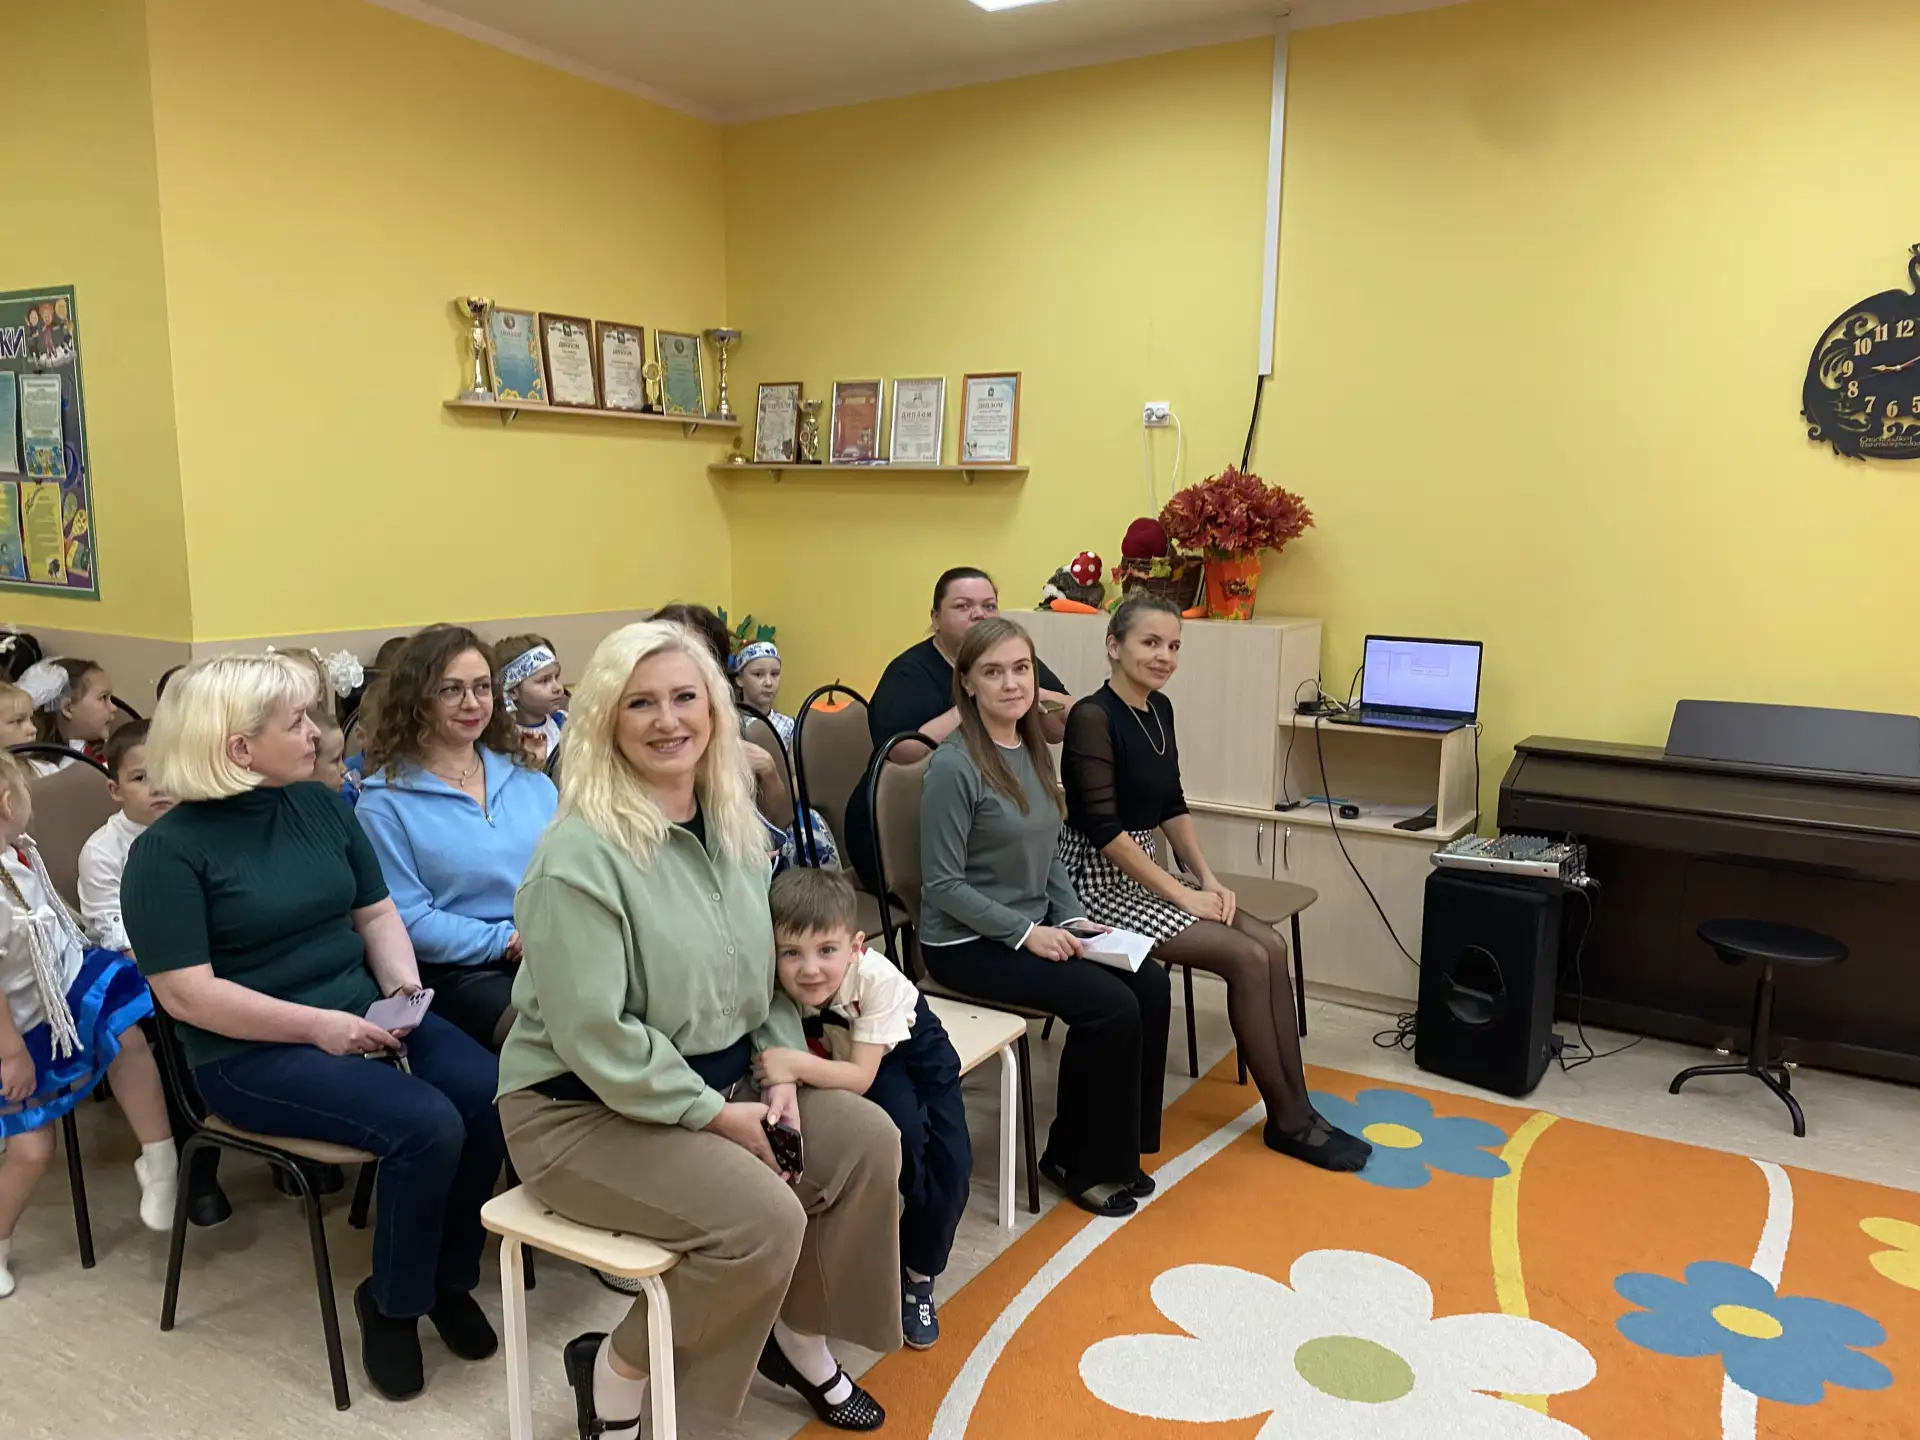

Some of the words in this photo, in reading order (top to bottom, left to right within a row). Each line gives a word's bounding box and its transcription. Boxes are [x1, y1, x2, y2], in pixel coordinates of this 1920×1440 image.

[1874, 323, 1888, 342] 11
[1895, 319, 1914, 338] 12
[1853, 338, 1872, 356] 10
[1842, 360, 1854, 378] 9
[1847, 380, 1859, 398] 8
[1864, 396, 1876, 413] 7
[1886, 400, 1898, 418] 6
